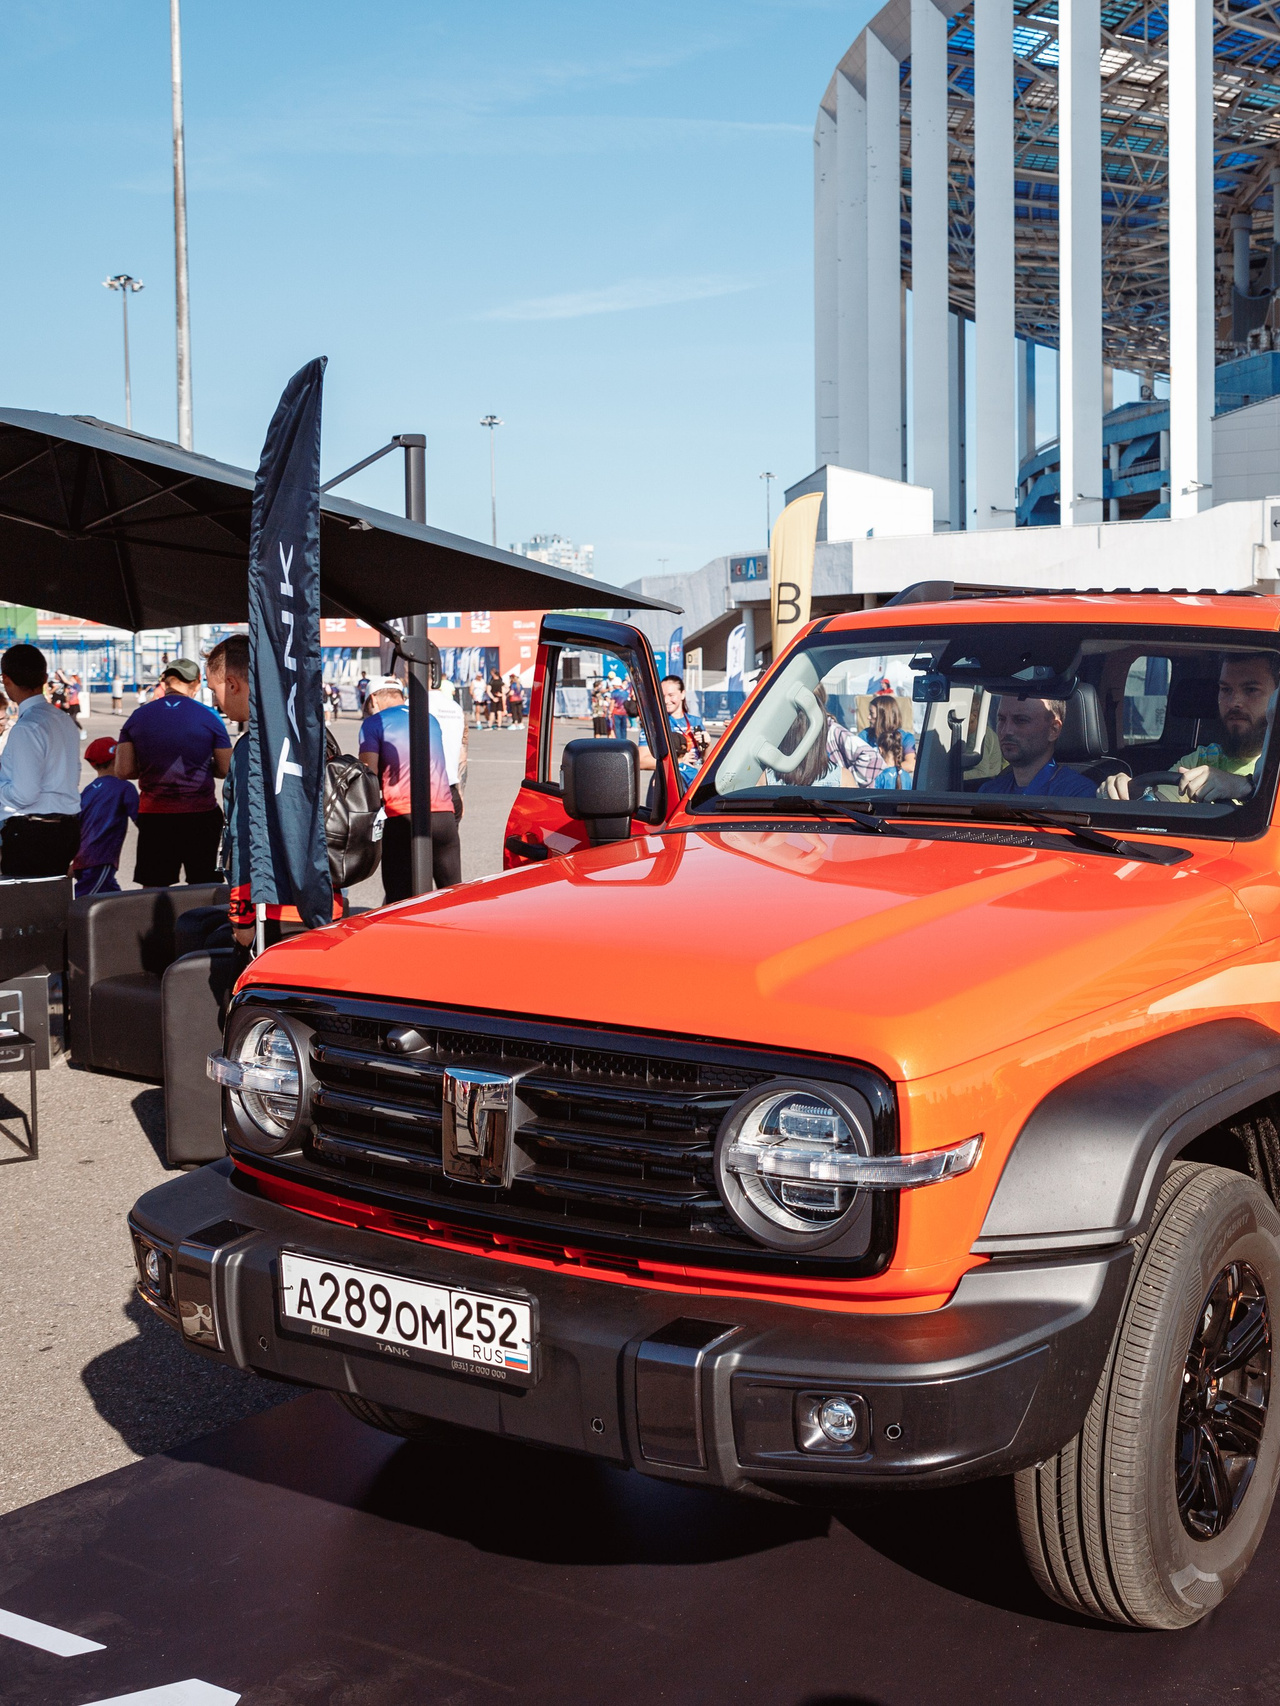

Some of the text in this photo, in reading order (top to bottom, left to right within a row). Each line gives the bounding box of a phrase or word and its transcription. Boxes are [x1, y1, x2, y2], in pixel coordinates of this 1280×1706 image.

[748, 559, 756, 578] A
[777, 582, 801, 625] B
[275, 541, 302, 795] TANK
[454, 1298, 518, 1349] 252
[376, 1342, 410, 1357] TANK
[473, 1345, 503, 1364] RUS
[452, 1360, 468, 1372] (831)
